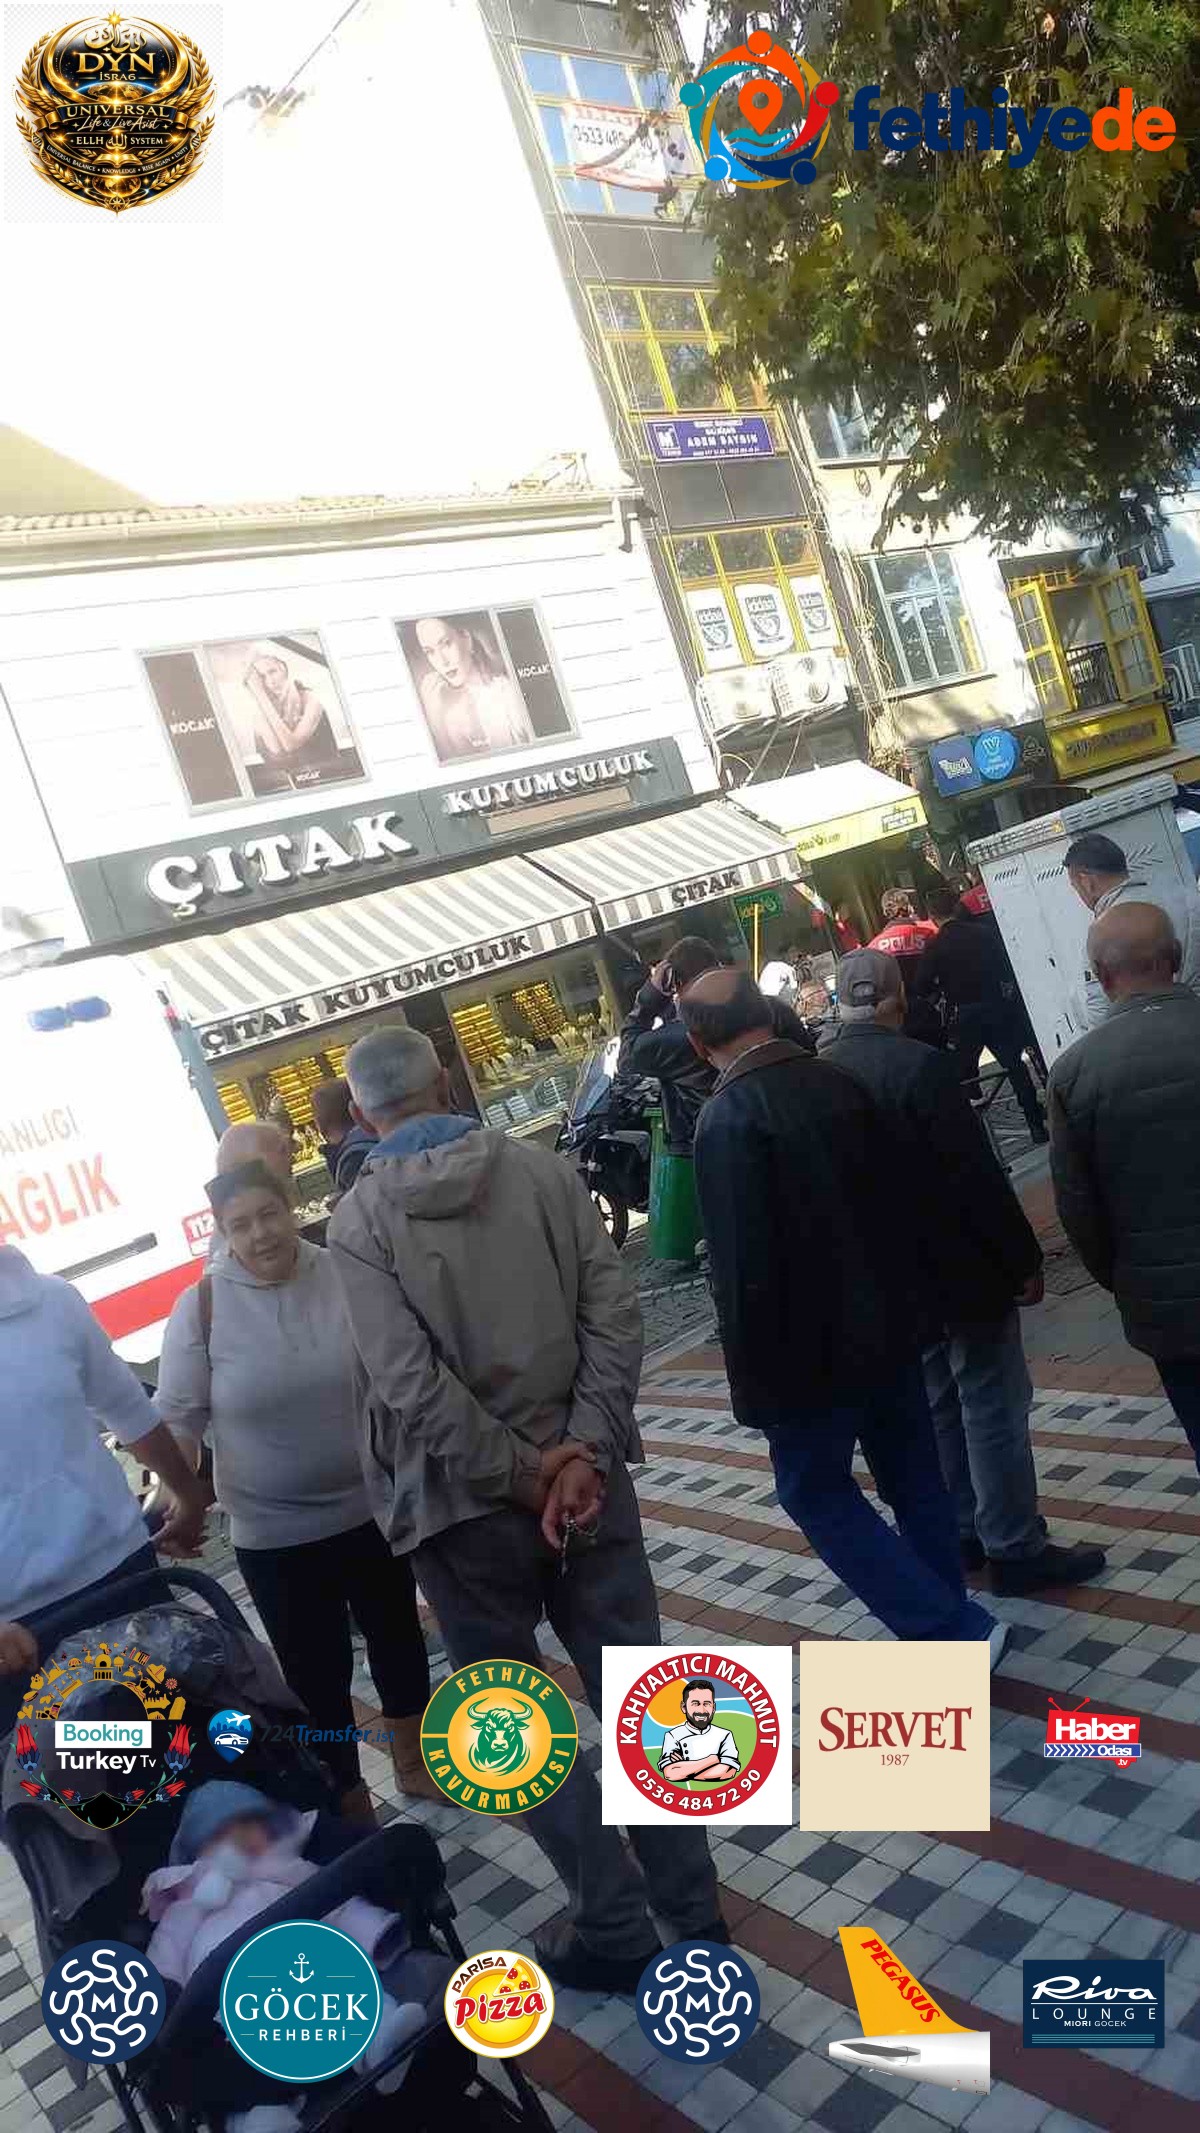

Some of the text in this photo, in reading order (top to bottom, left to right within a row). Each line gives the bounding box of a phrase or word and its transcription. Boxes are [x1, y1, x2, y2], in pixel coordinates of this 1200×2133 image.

[147, 750, 654, 918] ÇITAK KUYUMCULUK
[670, 869, 742, 908] ÇITAK
[200, 934, 532, 1056] ÇITAK KUYUMCULUK
